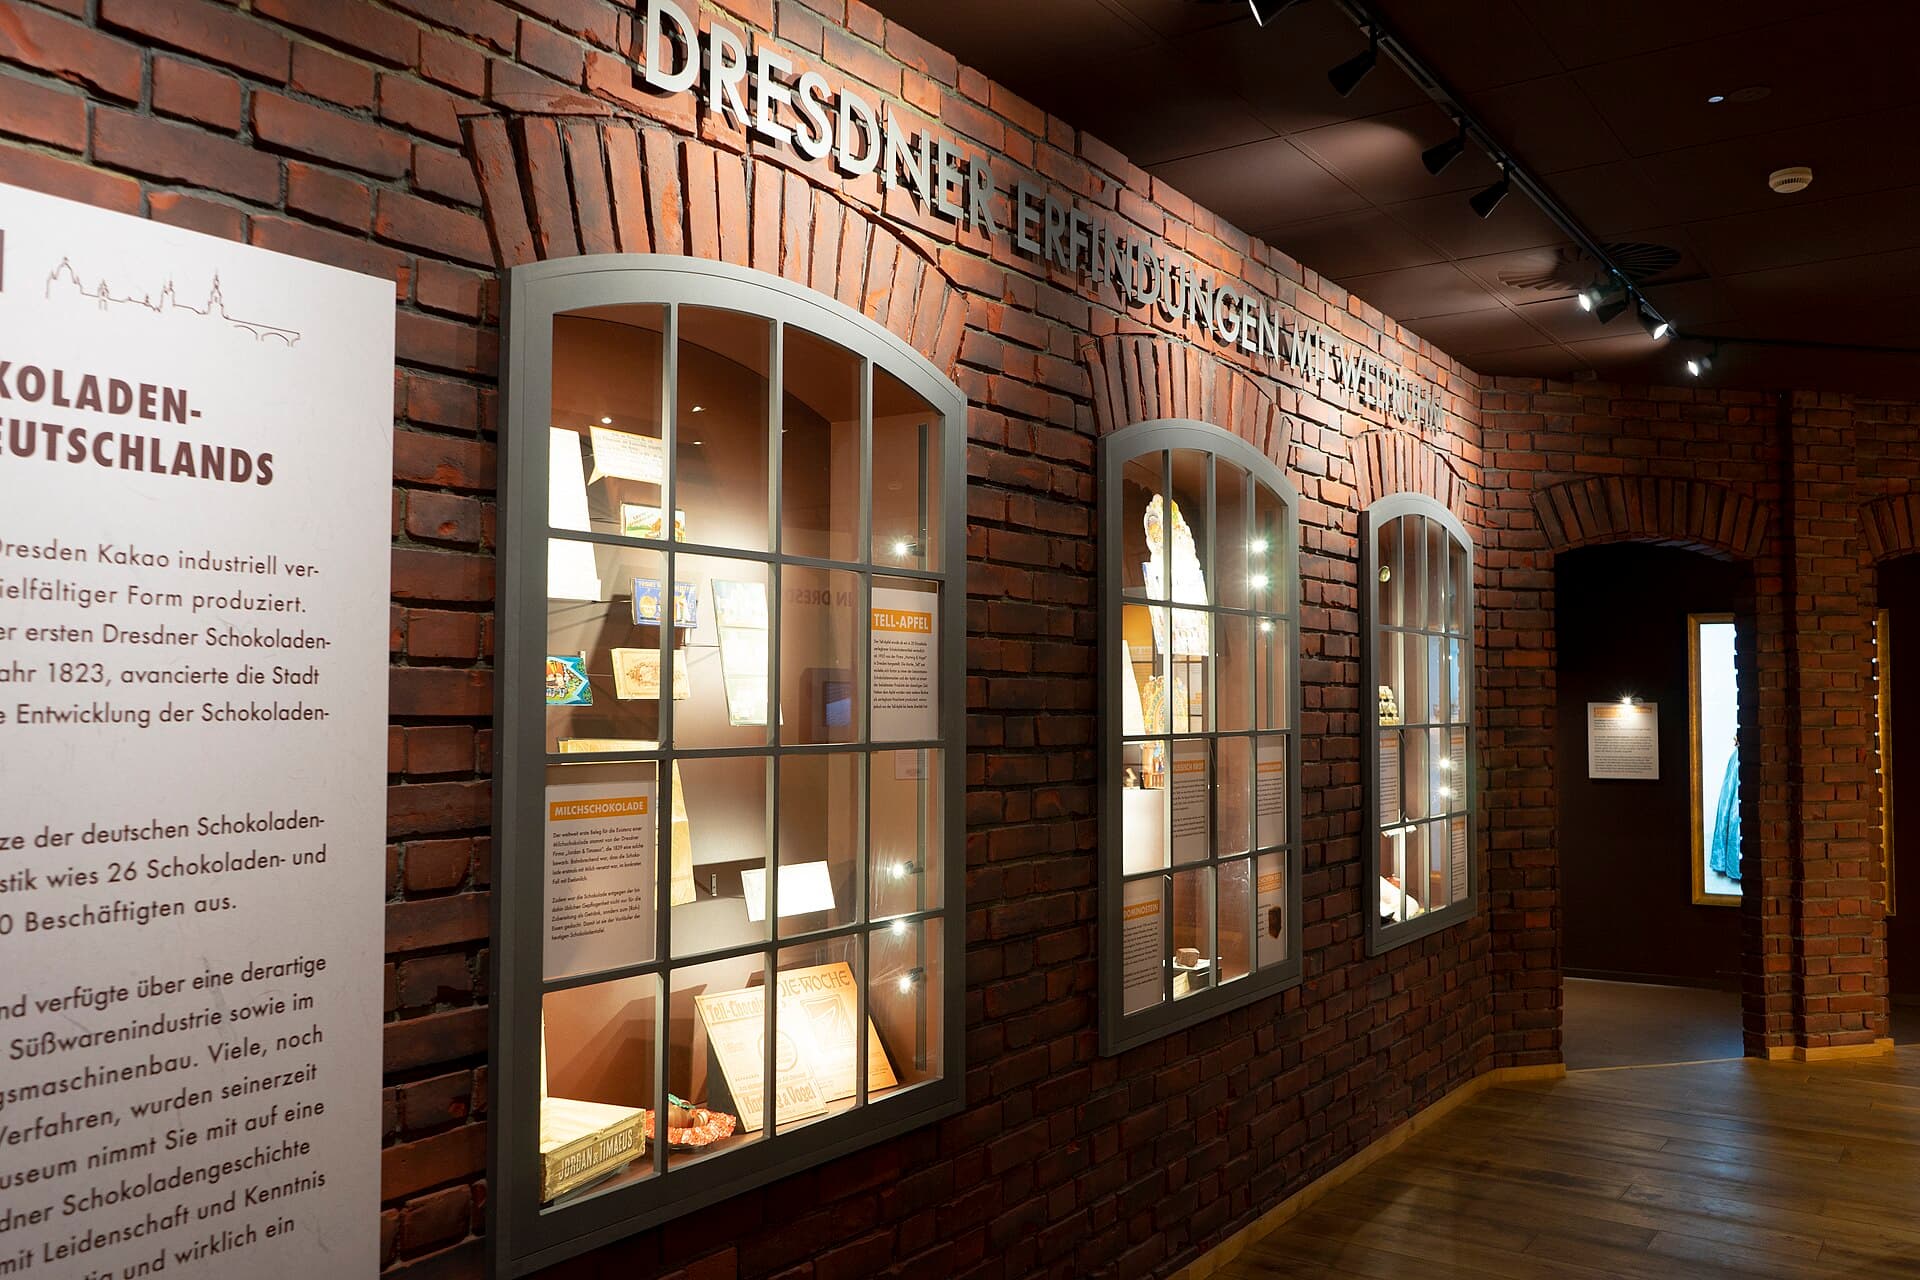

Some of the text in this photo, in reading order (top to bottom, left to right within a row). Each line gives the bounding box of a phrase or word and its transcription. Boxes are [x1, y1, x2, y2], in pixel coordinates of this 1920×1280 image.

[646, 0, 998, 235] DRESDNER
[1017, 180, 1280, 366] ERFINDUNGEN
[1290, 315, 1332, 384] MIT
[0, 417, 273, 486] UTSCHLANDS
[0, 538, 319, 577] resden Kakao industriell ver-
[128, 585, 182, 607] Form
[192, 589, 306, 614] produziert.
[874, 613, 928, 630] TELL-APFEL
[25, 625, 93, 642] ersten
[103, 624, 199, 645] Dresdner
[205, 626, 331, 649] Schokoladen-
[48, 663, 111, 687] 1823,
[120, 665, 229, 684] avancierte
[236, 664, 265, 684] die
[272, 665, 320, 684] Stadt
[17, 701, 151, 728] Entwicklung
[159, 701, 194, 722] der
[201, 701, 330, 722] Schokoladen-
[34, 825, 75, 848] der
[81, 818, 189, 844] deutschen
[197, 809, 325, 836] Schokoladen-
[554, 801, 643, 816] MILCHSCHOKOLADE
[46, 867, 99, 888] wies
[107, 861, 137, 883] 26
[146, 849, 286, 879] Schokoladen-
[293, 843, 326, 865] und
[25, 900, 184, 932] Beschäftigten
[194, 897, 236, 912] aus.
[35, 985, 129, 1013] verfügte
[137, 975, 186, 998] über
[192, 969, 234, 990] eine
[241, 956, 326, 982] derartige
[9, 993, 313, 1060] Süßwarenindustrie sowie im
[208, 1037, 267, 1063] Viele,
[277, 1024, 323, 1051] noch
[130, 1087, 212, 1118] wurden
[221, 1063, 317, 1099] seinerzeit
[88, 1137, 157, 1169] nimmt
[165, 1128, 197, 1150] Sie
[206, 1118, 237, 1141] mit
[245, 1105, 278, 1131] auf
[284, 1102, 324, 1122] eine
[559, 1147, 593, 1181] JORDAN
[600, 1129, 633, 1163] TIMAEUS
[62, 1140, 310, 1216] Schokoladengeschichte
[44, 1204, 189, 1263] Leidenschaft
[198, 1190, 236, 1220] und
[245, 1170, 325, 1207] Kenntnis
[124, 1248, 165, 1280] und
[174, 1224, 256, 1264] wirklich
[266, 1217, 294, 1238] ein
